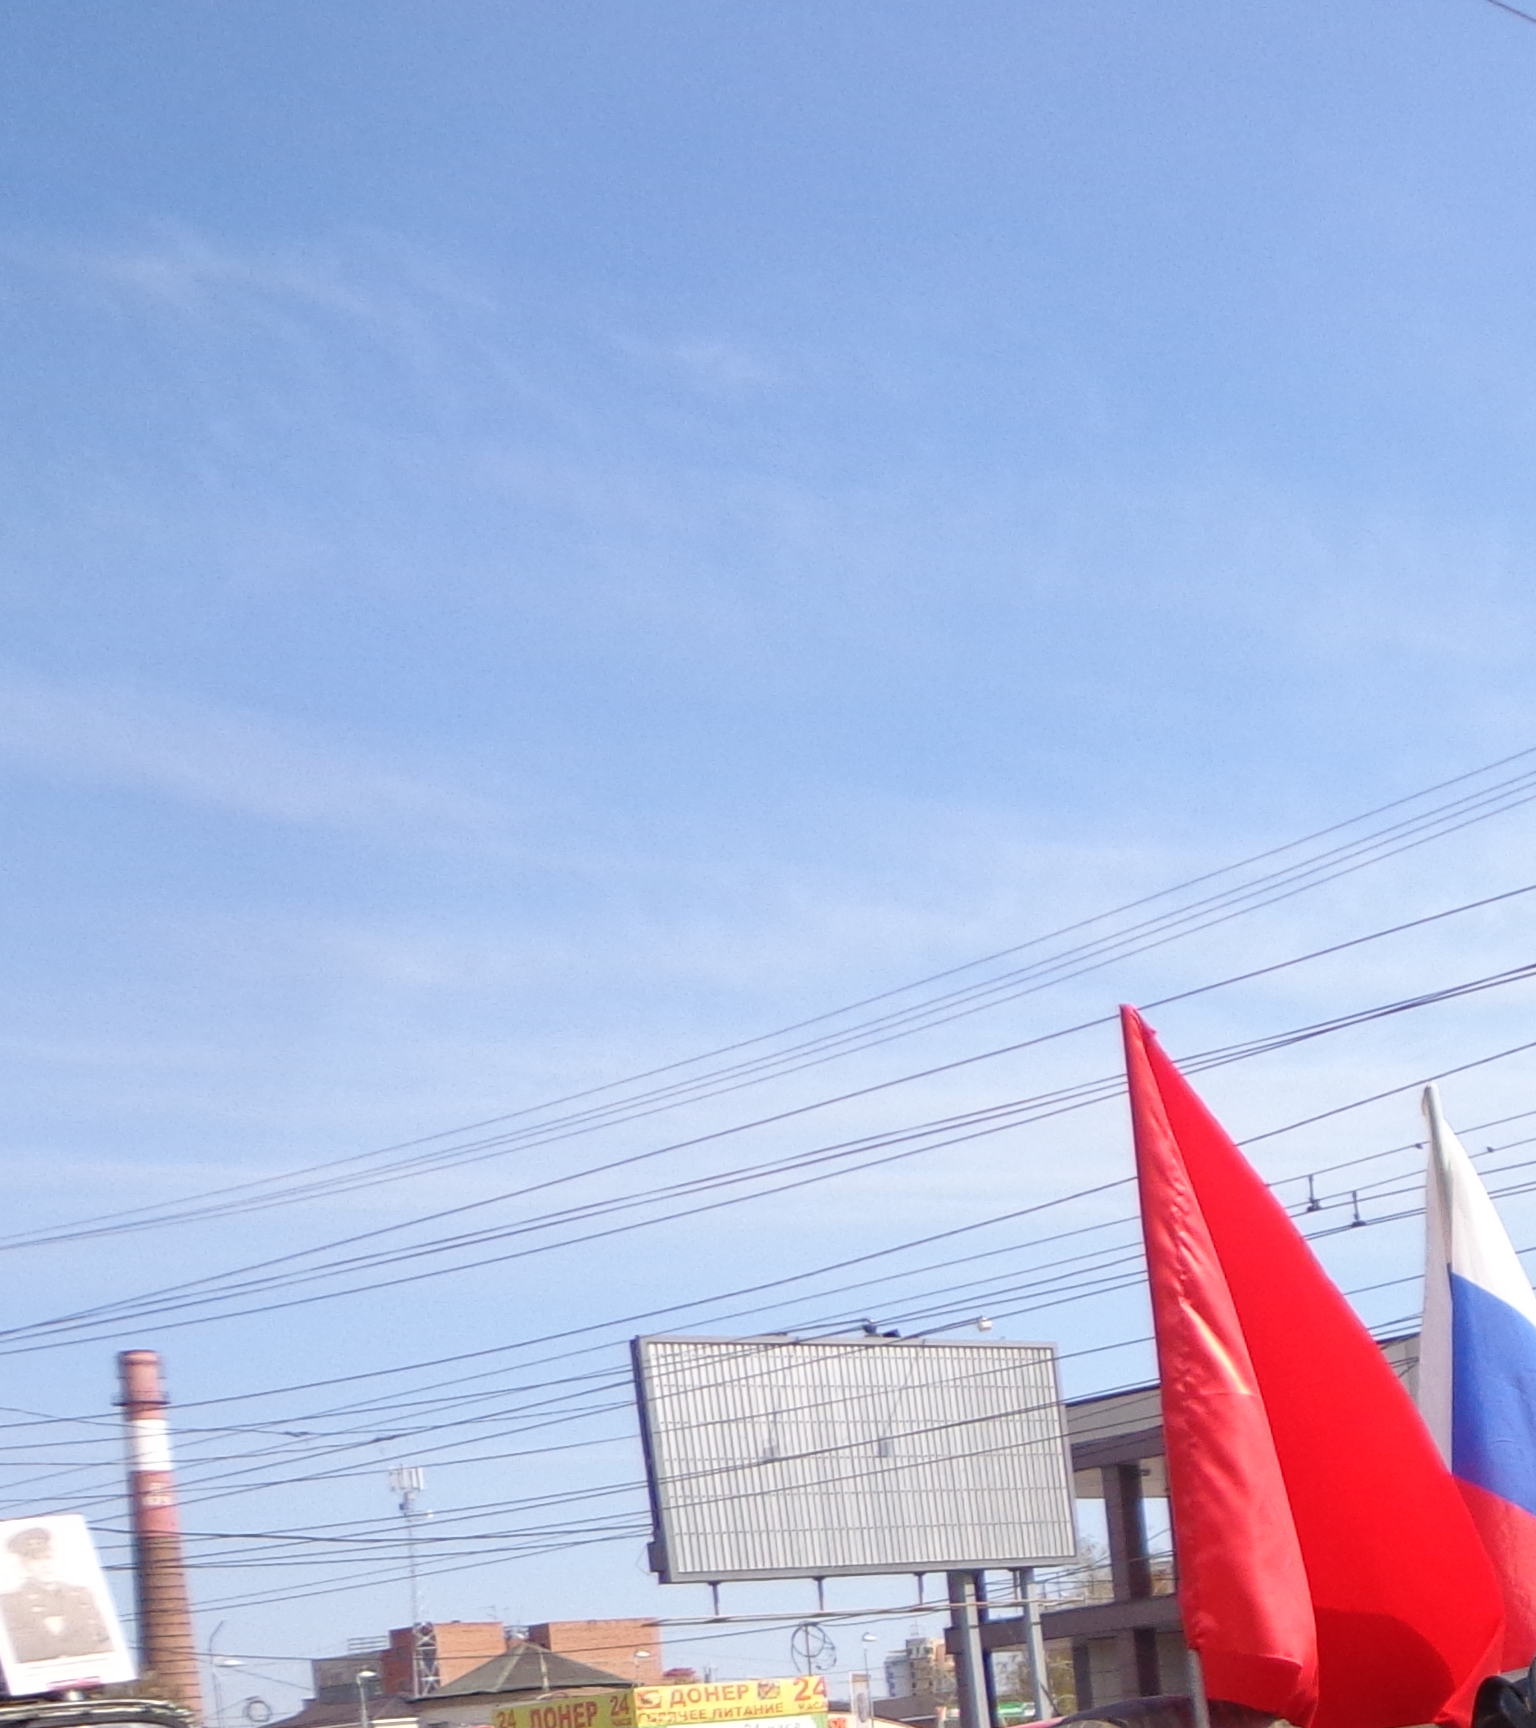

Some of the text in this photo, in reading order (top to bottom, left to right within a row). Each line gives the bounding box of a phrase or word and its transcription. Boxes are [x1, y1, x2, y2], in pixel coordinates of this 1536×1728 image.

[670, 1677, 827, 1708] ДОНЕР 24
[610, 1695, 630, 1717] 24
[712, 1702, 784, 1720] ПИТАНИЕ
